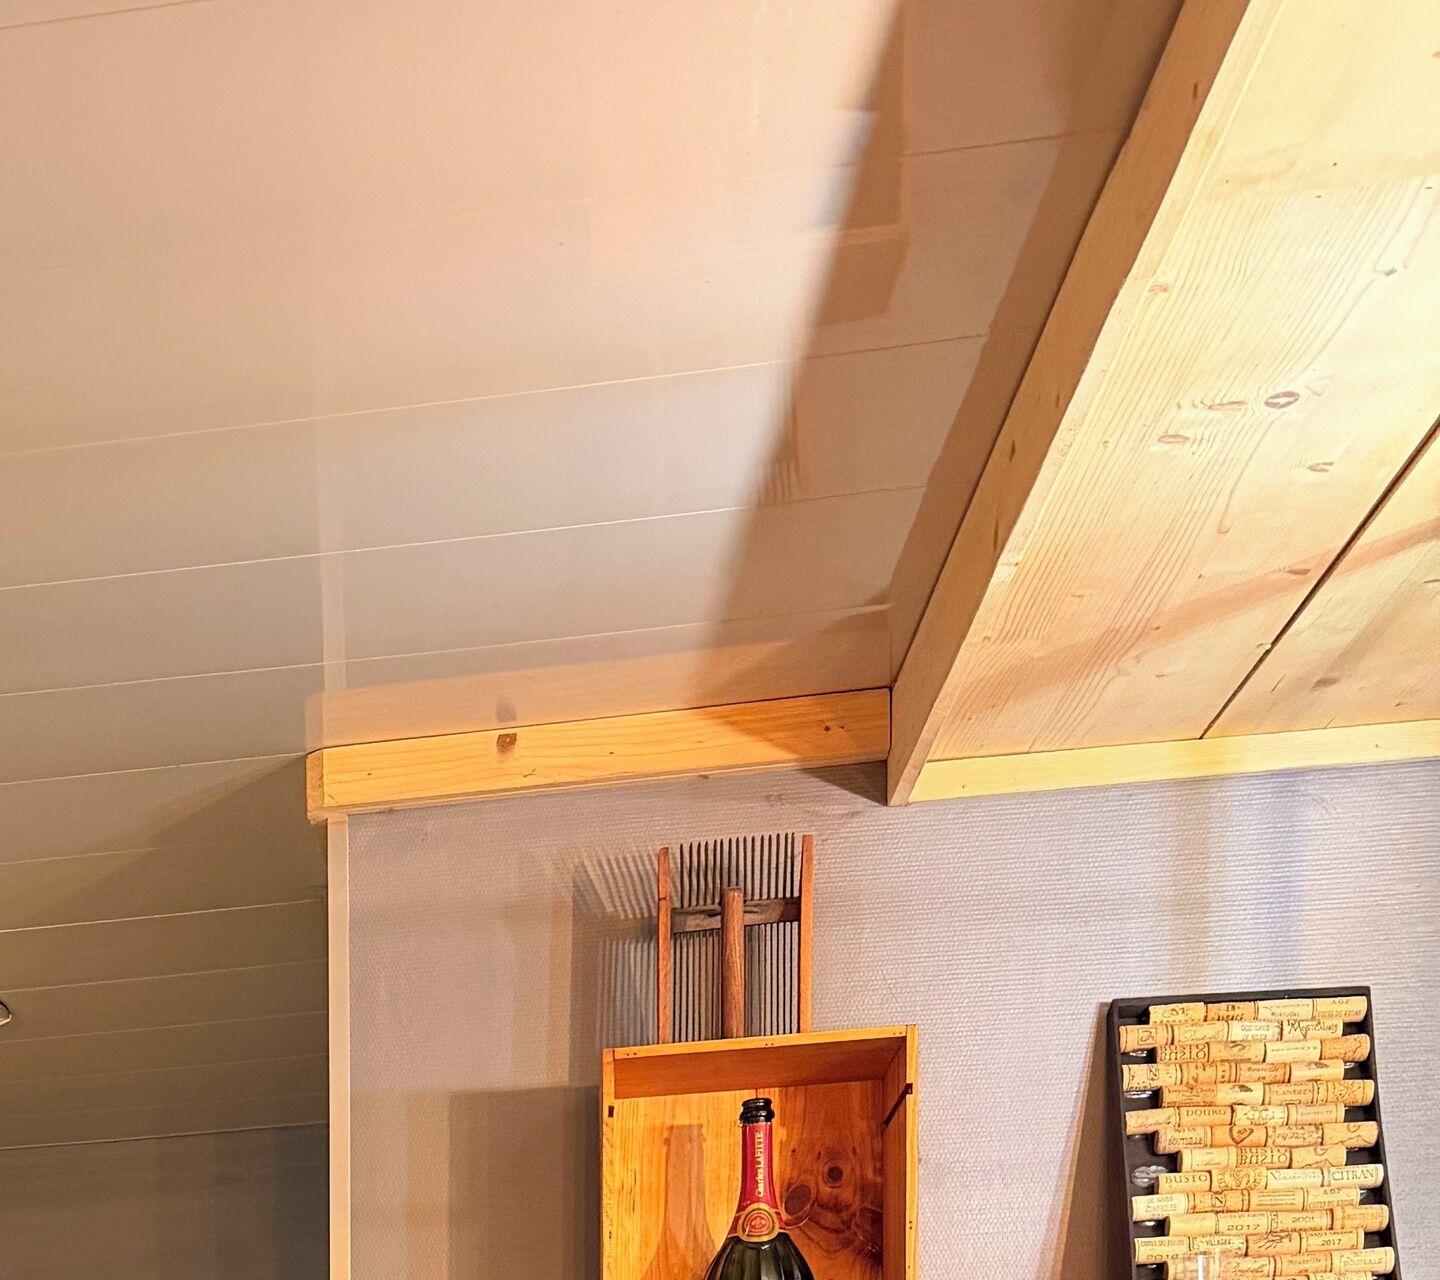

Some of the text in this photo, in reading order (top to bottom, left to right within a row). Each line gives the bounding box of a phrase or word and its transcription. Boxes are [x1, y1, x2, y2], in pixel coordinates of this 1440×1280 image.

[1164, 1173, 1208, 1184] BUSTO
[1331, 1168, 1375, 1182] CITRAN
[1226, 1223, 1261, 1232] 2017
[1321, 1238, 1342, 1246] 2017
